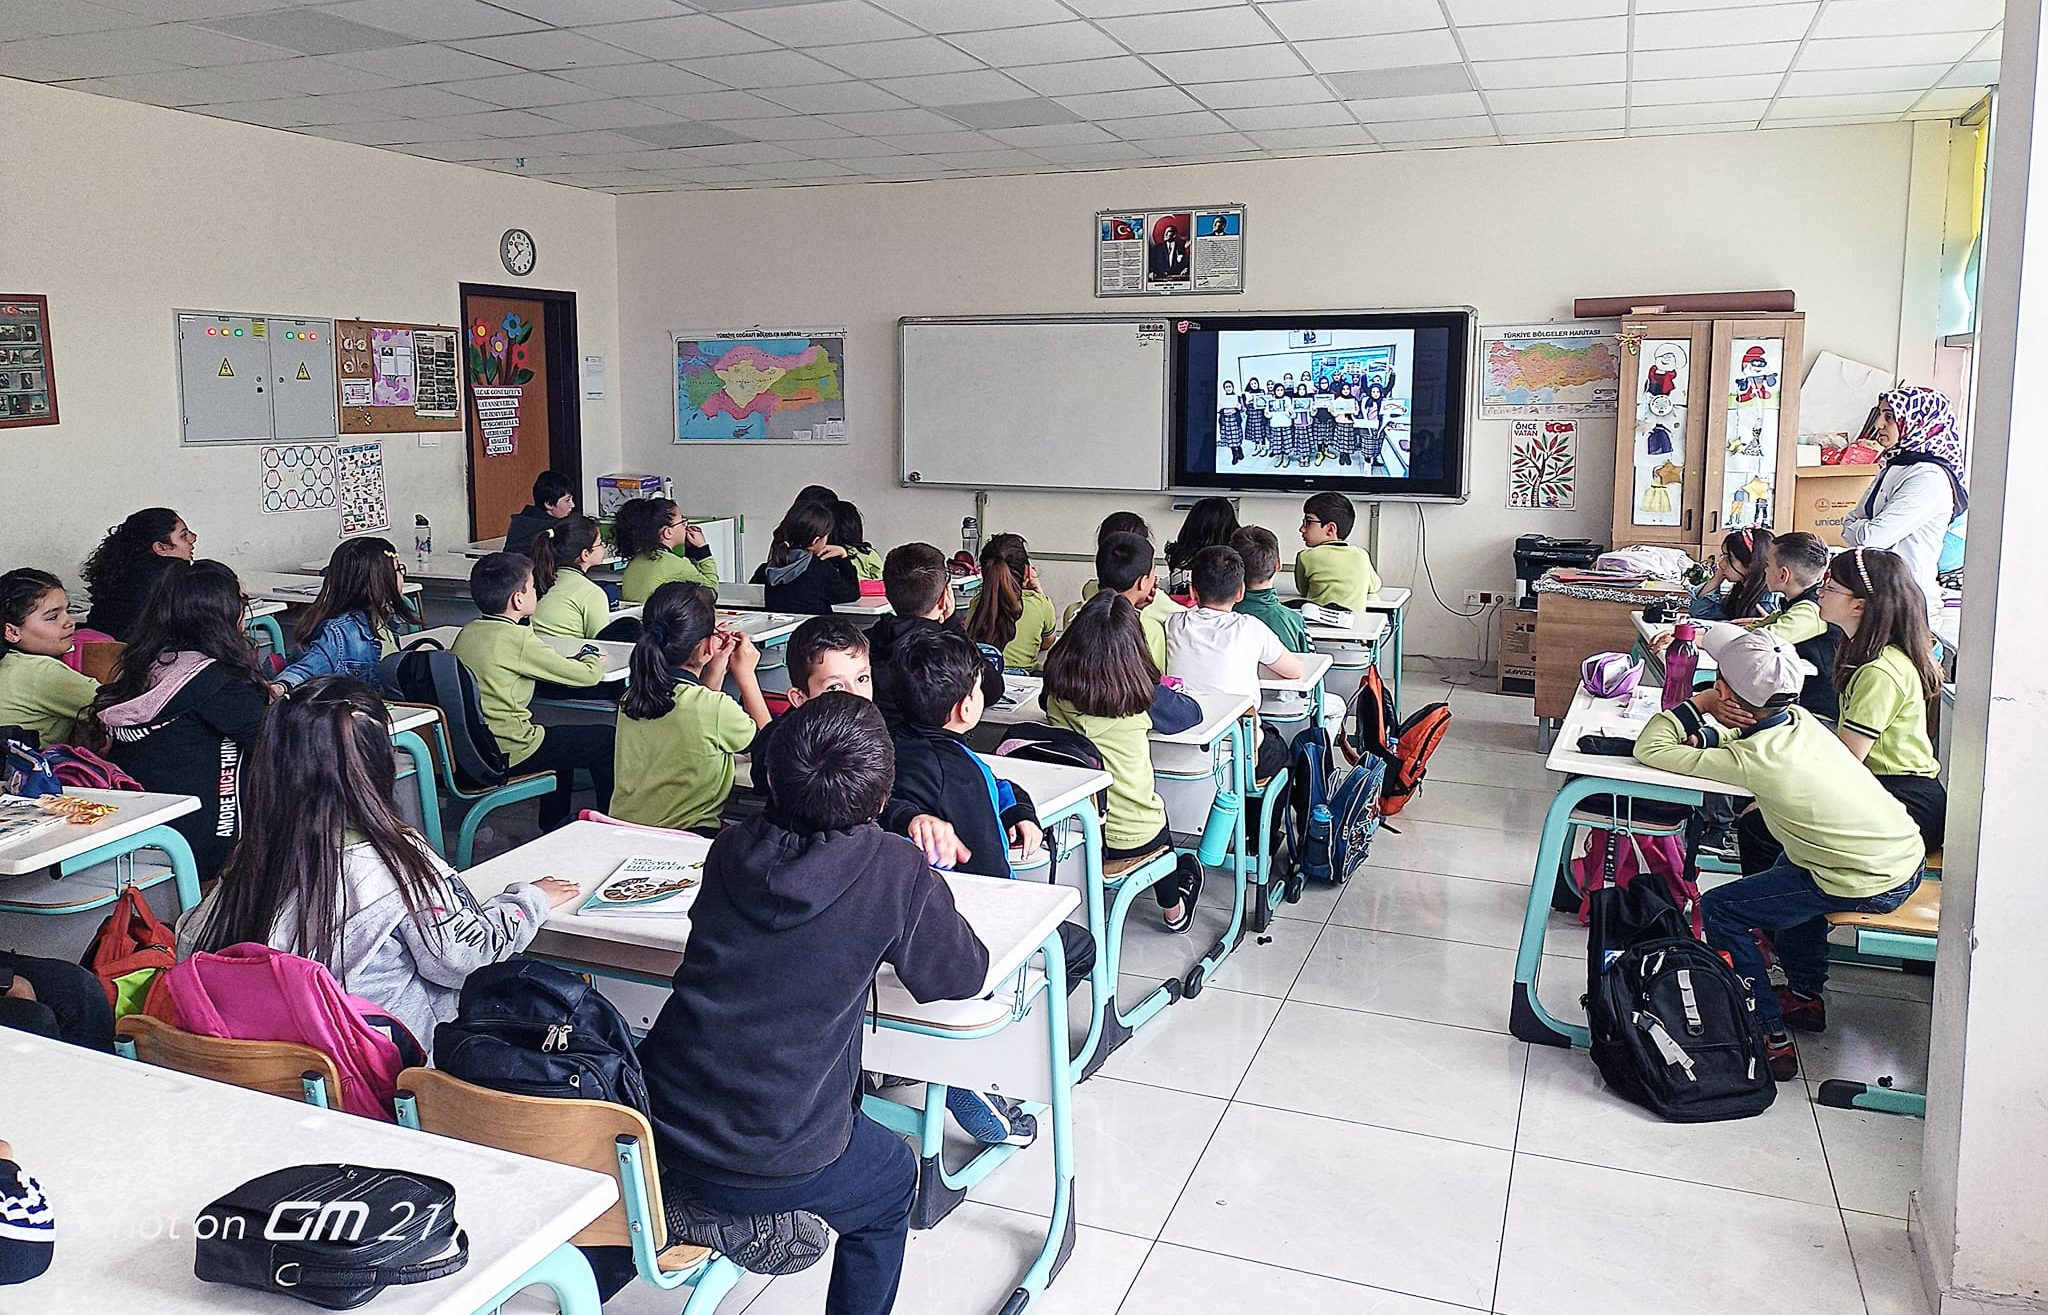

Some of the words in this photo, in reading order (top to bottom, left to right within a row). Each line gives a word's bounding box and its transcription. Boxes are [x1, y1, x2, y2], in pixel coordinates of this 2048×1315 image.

[1503, 331, 1531, 339] TÜRKİYE
[1532, 330, 1568, 338] BÖLGELER
[1569, 328, 1601, 336] HARİTASI
[1515, 421, 1537, 430] ÖNCE
[219, 769, 235, 796] NICE
